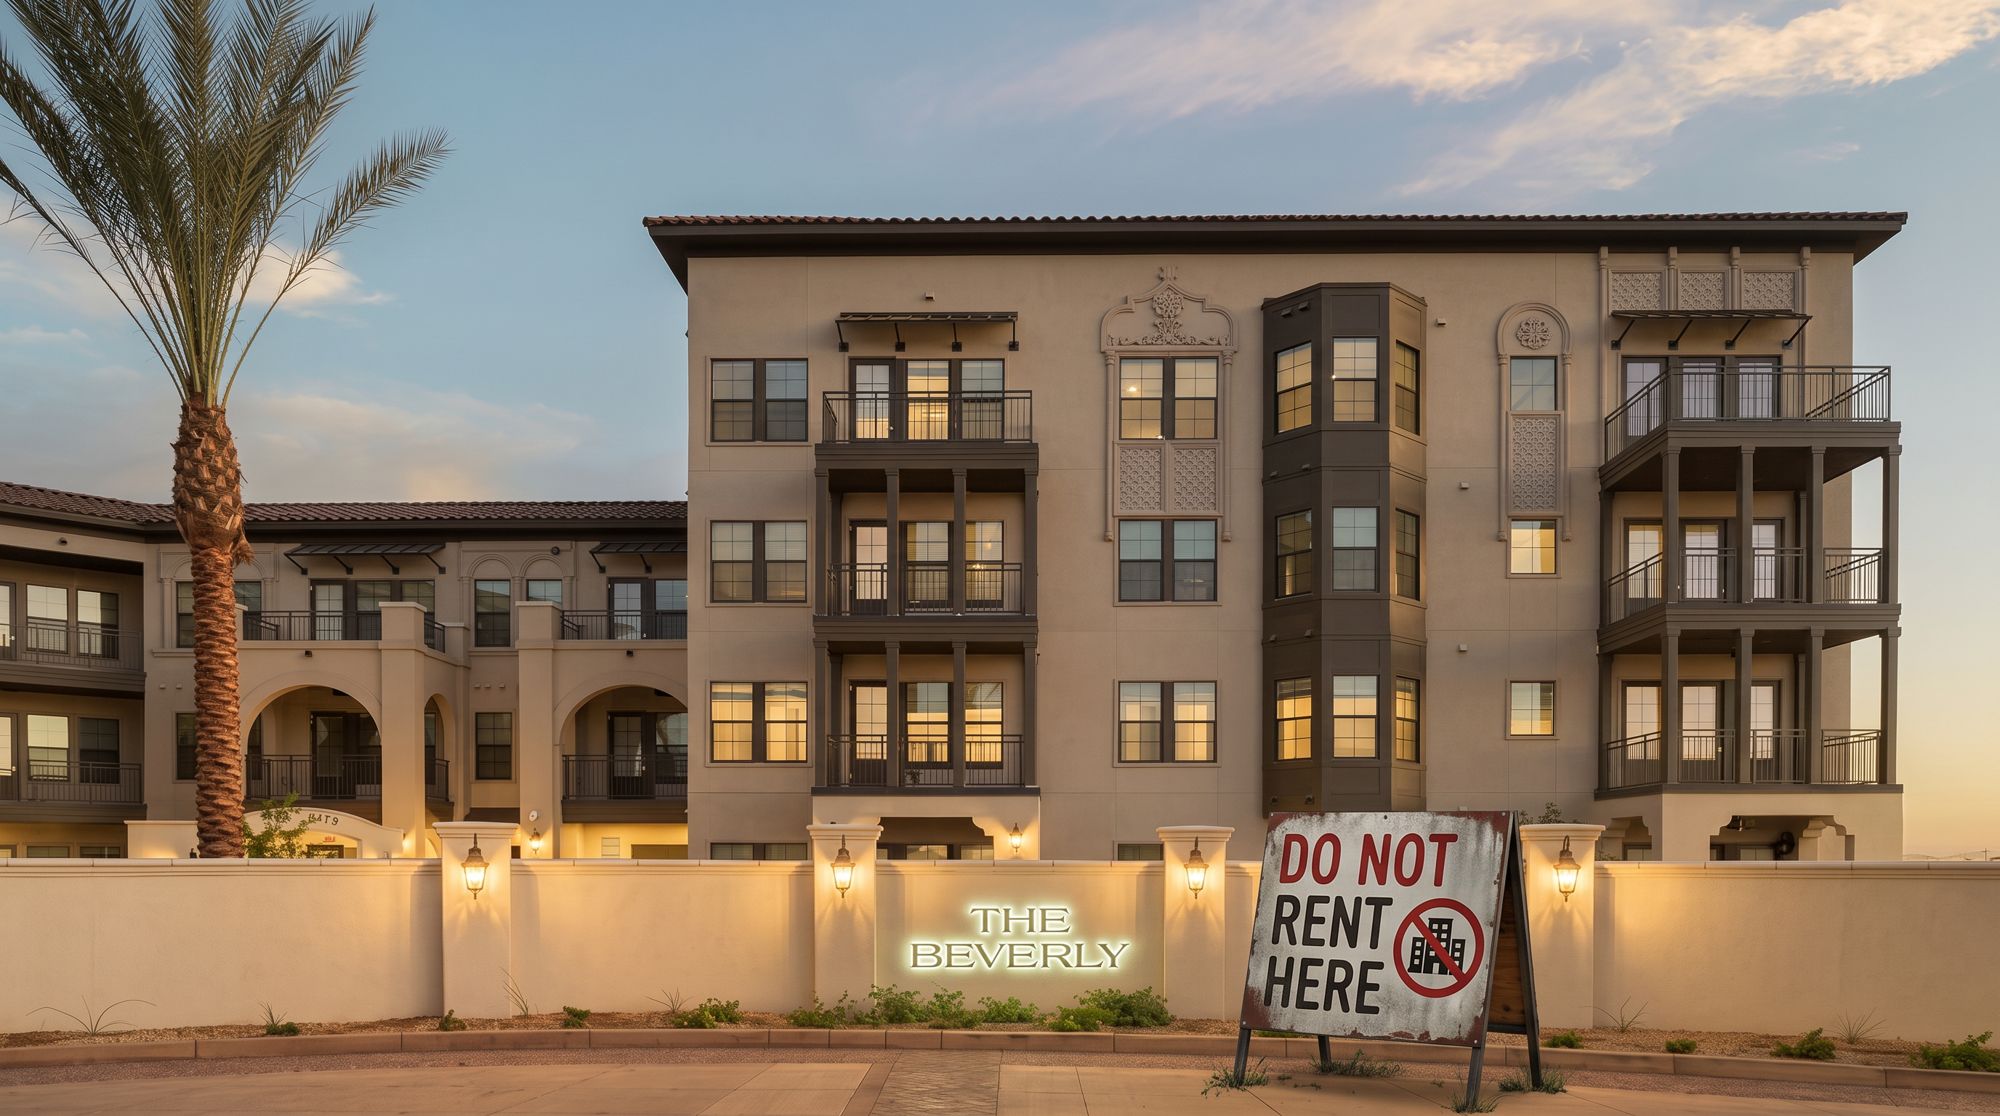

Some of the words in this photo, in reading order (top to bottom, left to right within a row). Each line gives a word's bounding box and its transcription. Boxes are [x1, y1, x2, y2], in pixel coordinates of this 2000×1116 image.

[1279, 833, 1342, 885] DO
[1357, 833, 1459, 887] NOT
[970, 907, 1071, 933] THE
[1271, 895, 1394, 950] RENT
[911, 943, 1130, 968] BEVERLY
[1263, 955, 1385, 1015] HERE
